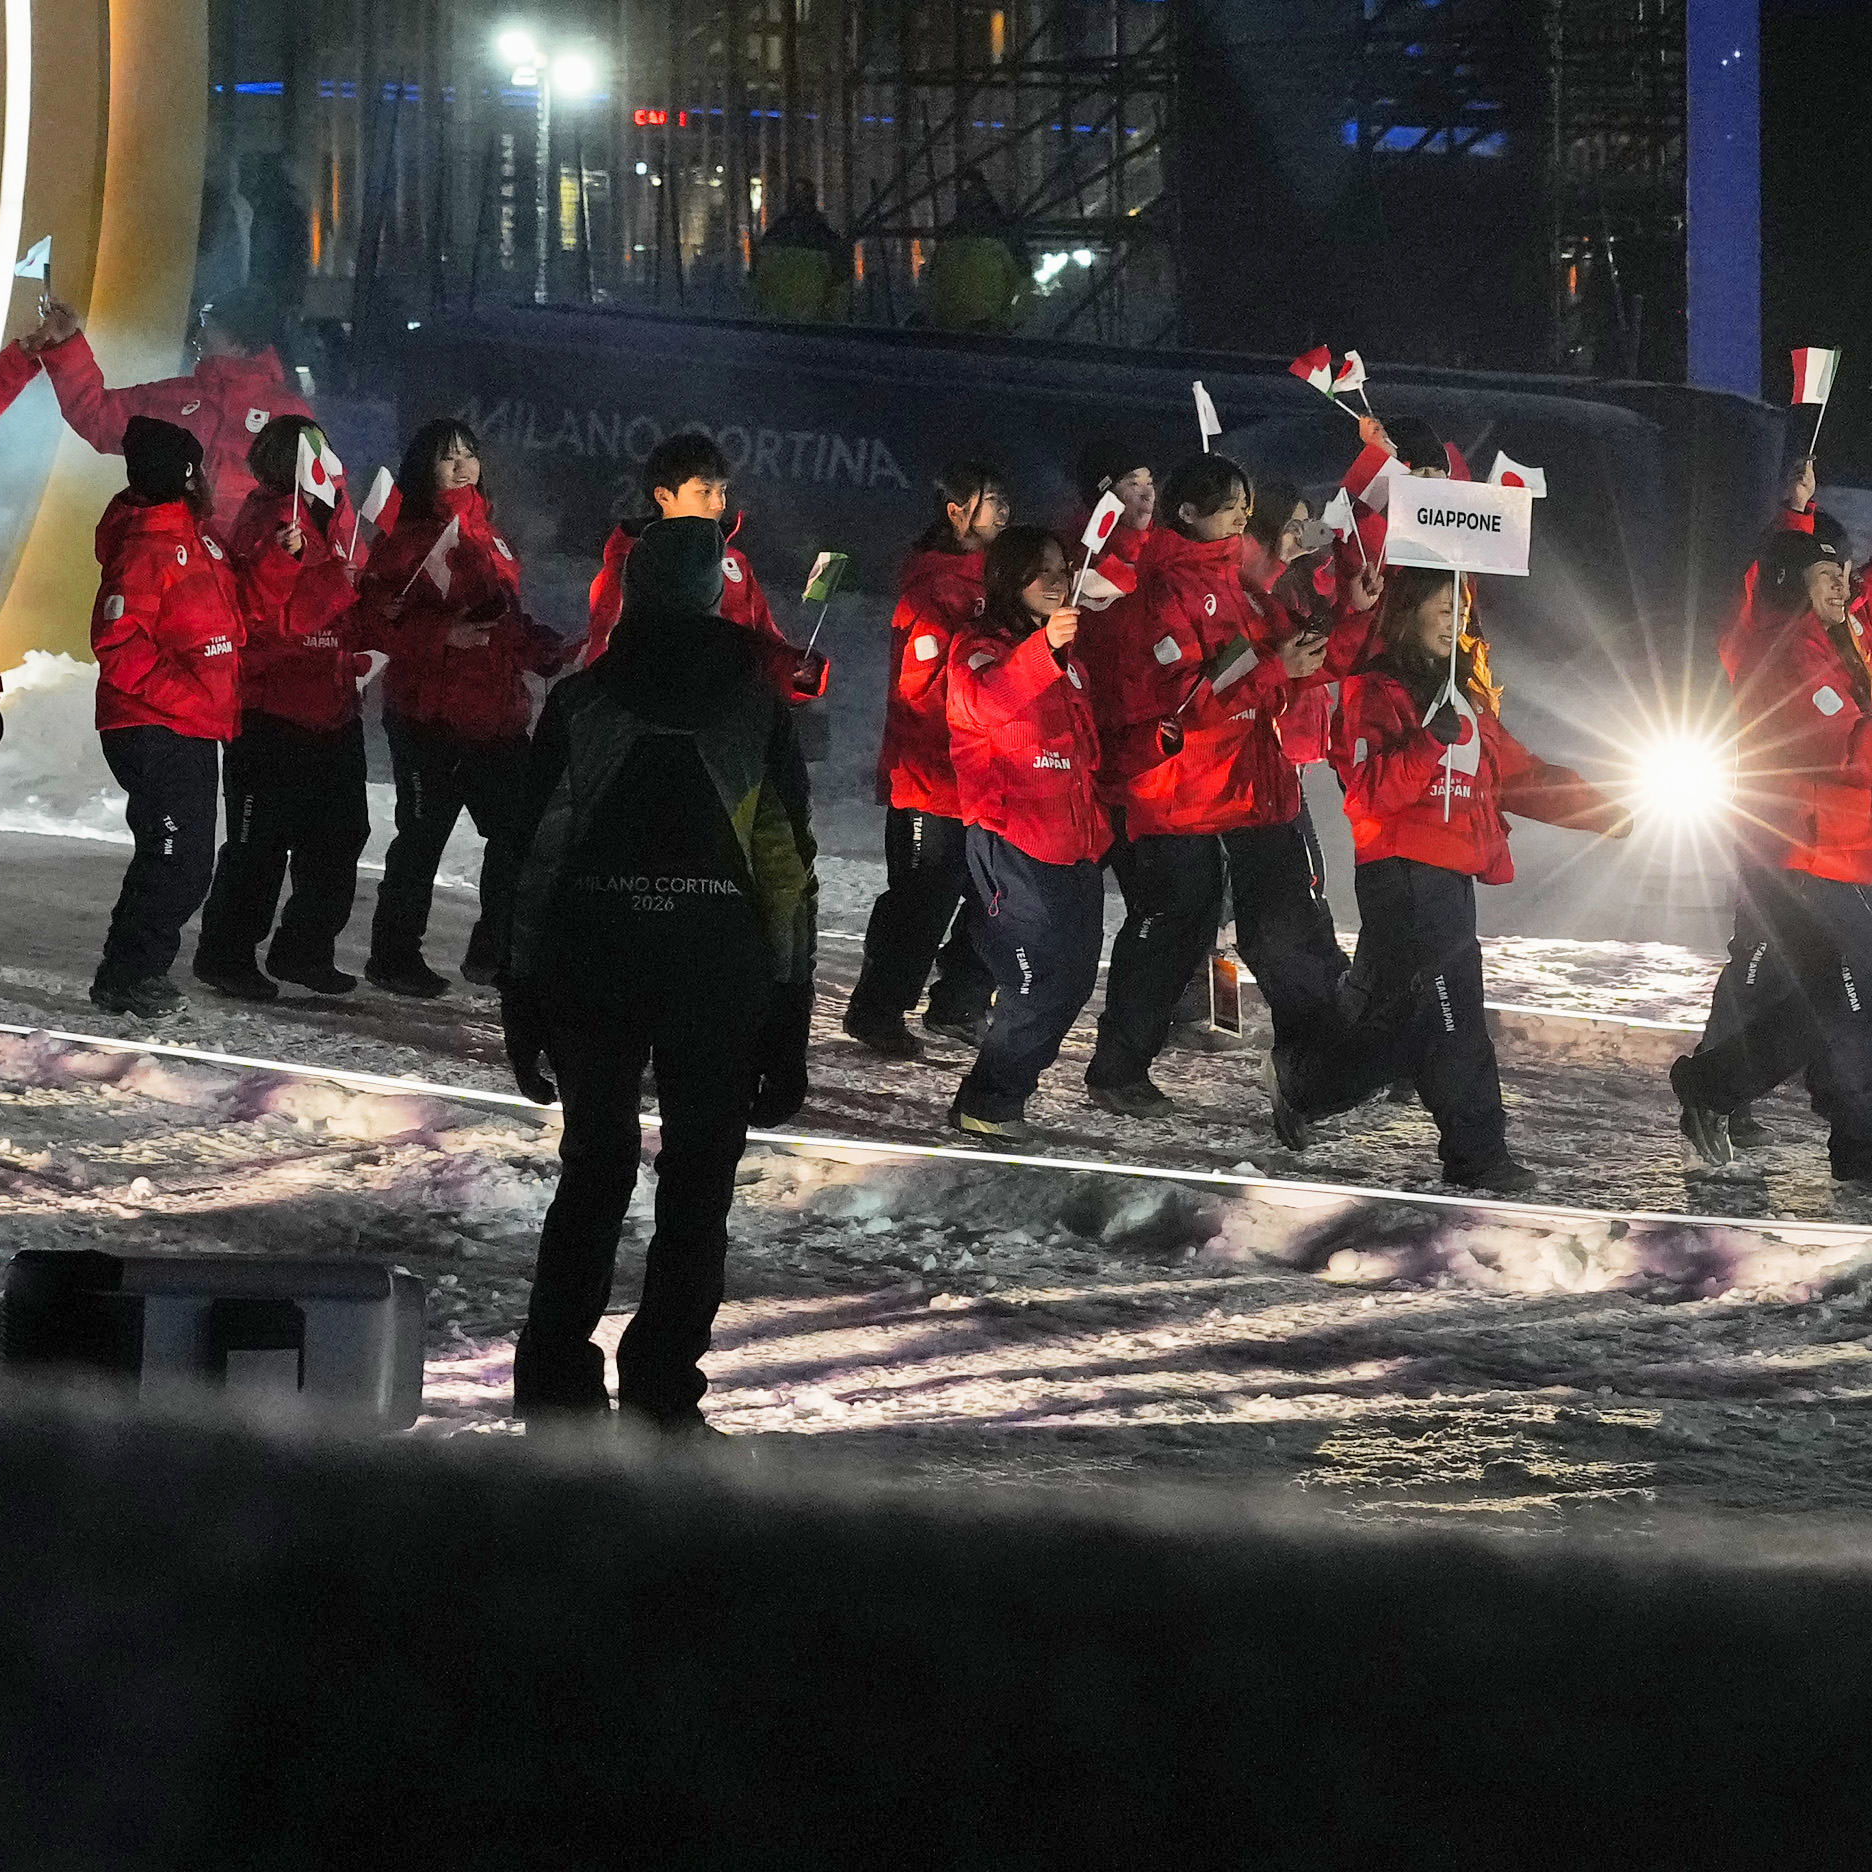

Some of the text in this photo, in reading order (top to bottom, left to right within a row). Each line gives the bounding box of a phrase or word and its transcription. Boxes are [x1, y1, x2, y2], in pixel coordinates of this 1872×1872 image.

[680, 422, 912, 489] ORTINA
[1417, 507, 1501, 532] GIAPPONE
[204, 641, 233, 657] JAPAN
[303, 635, 339, 648] JAPAN
[1033, 756, 1071, 770] JAPAN
[1440, 777, 1462, 785] TAM
[655, 876, 743, 896] CORTINA
[631, 895, 675, 911] 2026
[1016, 947, 1030, 971] TEAM
[1435, 975, 1456, 1032] TEAM JAPAN
[1845, 982, 1862, 1012] JAPAN
